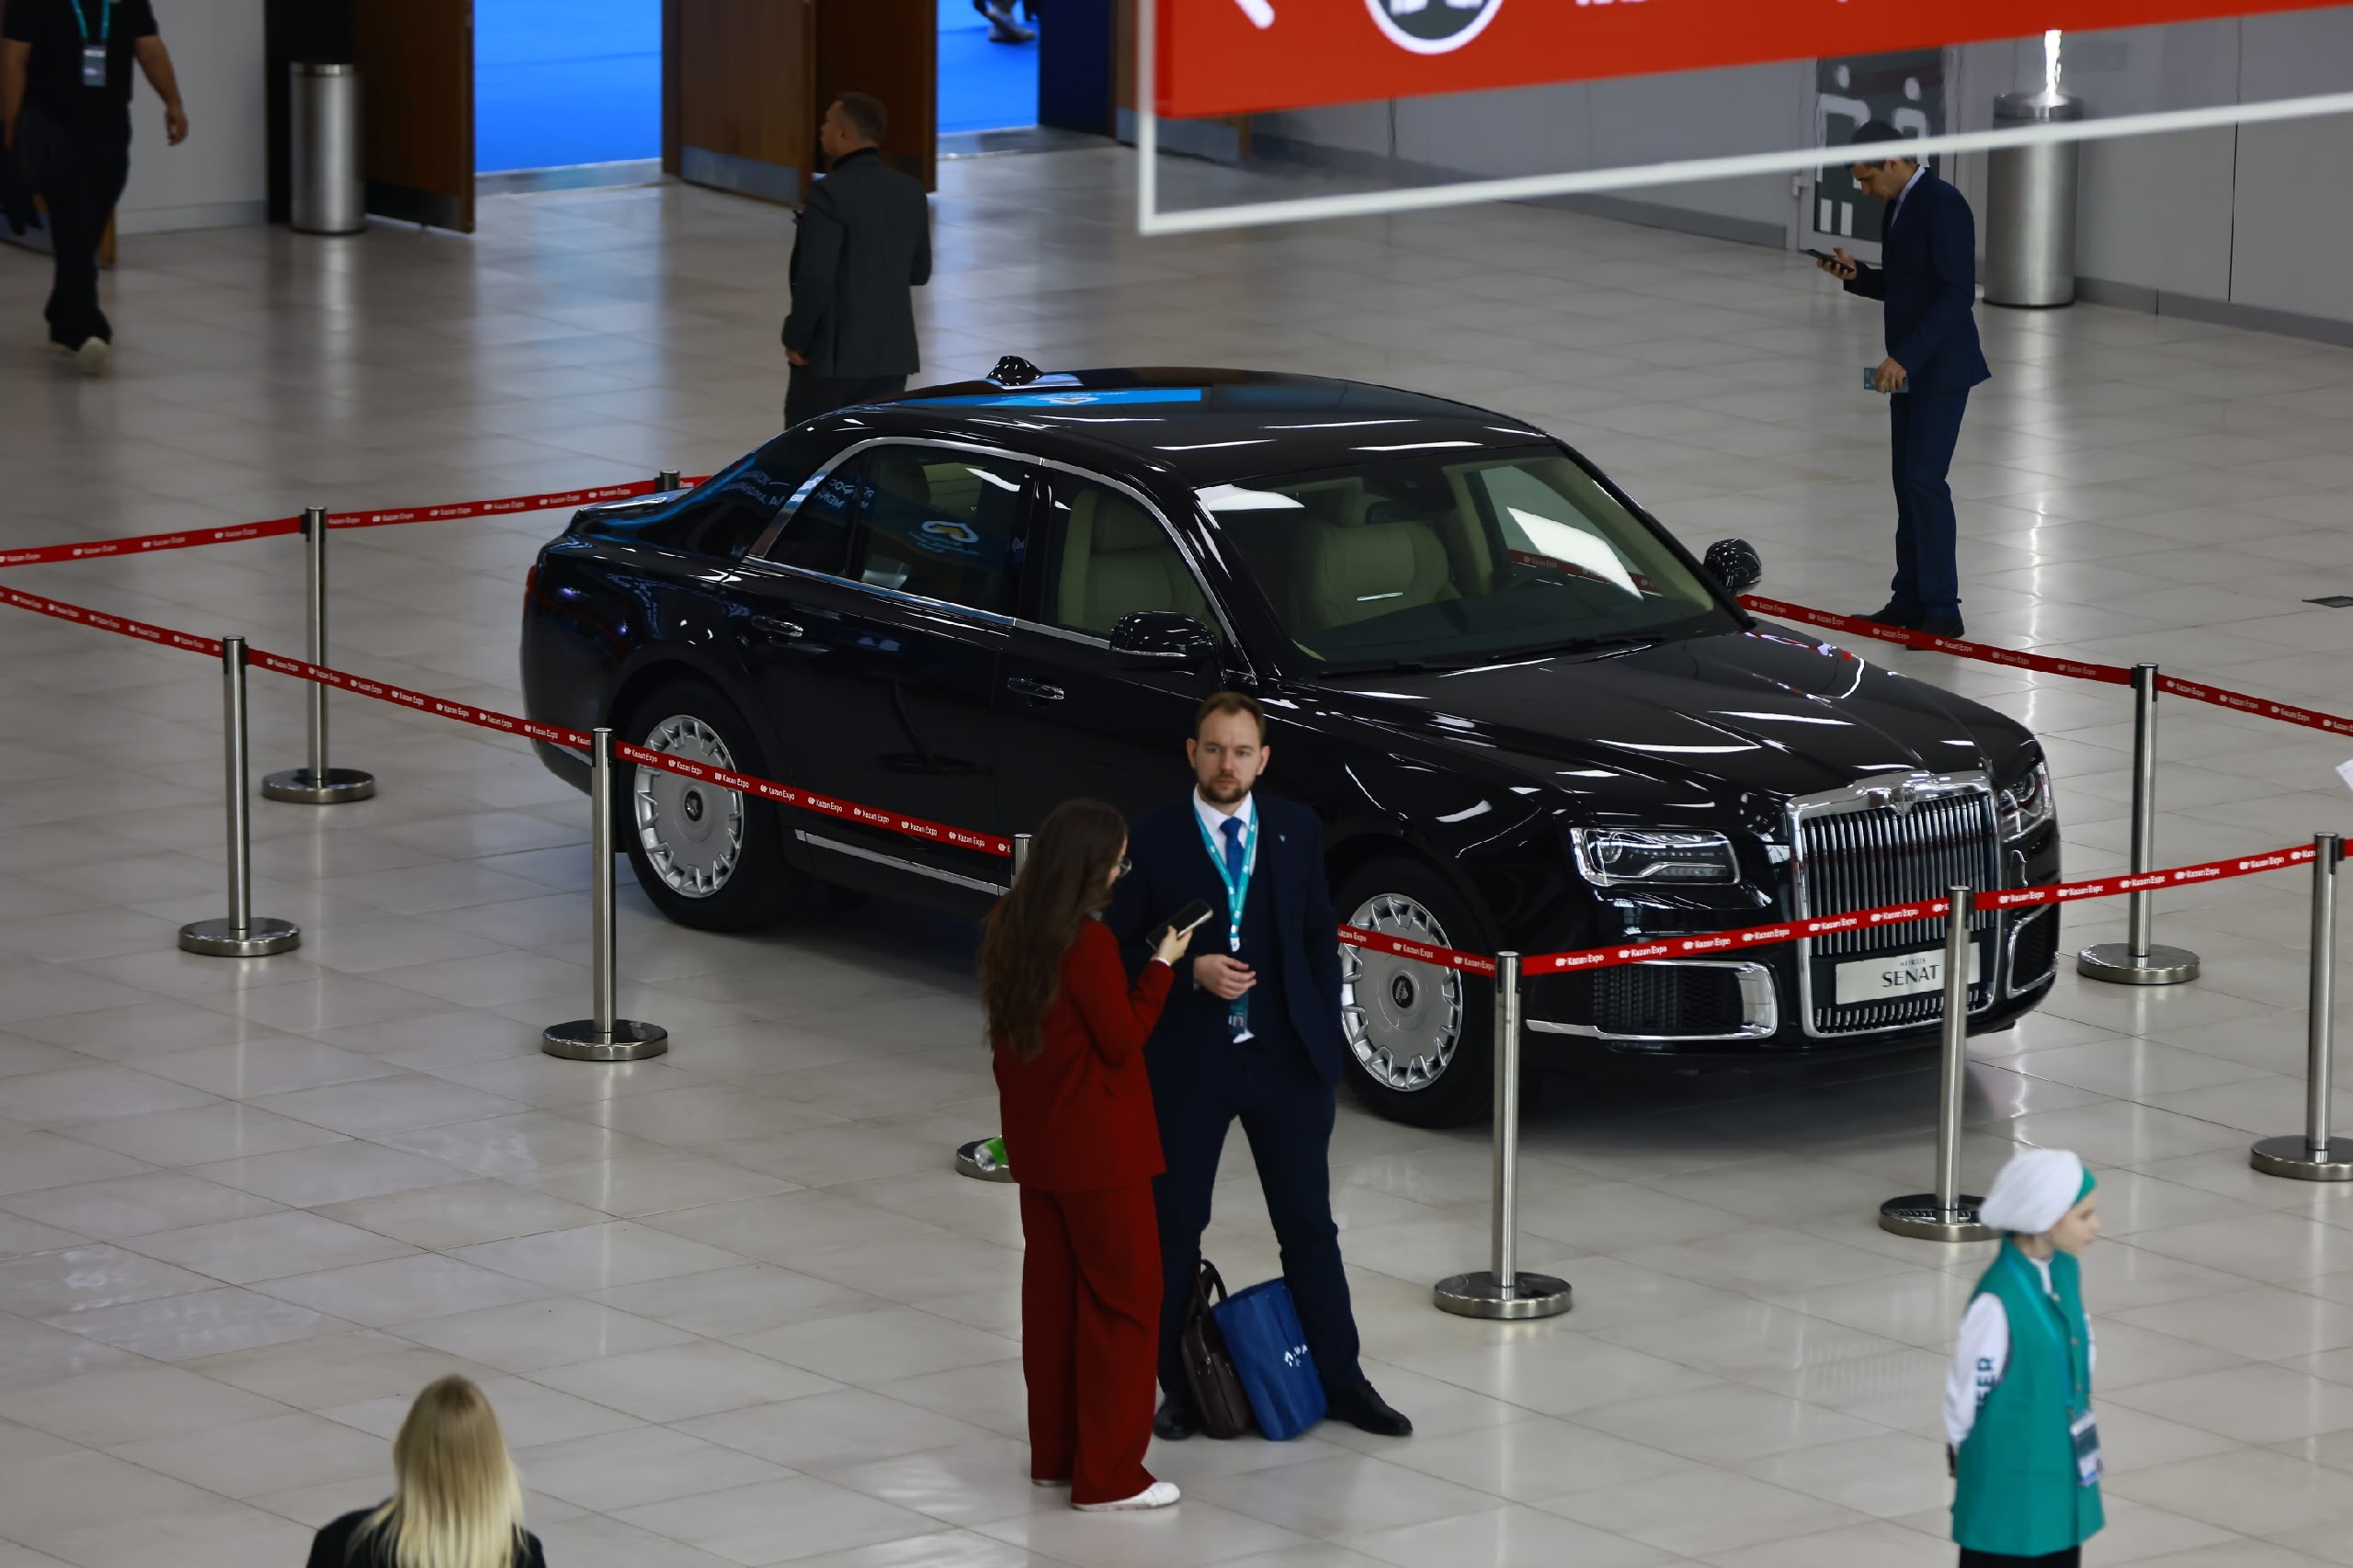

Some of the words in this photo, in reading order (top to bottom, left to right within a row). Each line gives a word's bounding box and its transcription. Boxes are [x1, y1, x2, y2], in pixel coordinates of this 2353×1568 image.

[546, 730, 558, 740] Expo
[631, 749, 645, 759] Kazan
[645, 753, 658, 763] Expo
[676, 761, 690, 771] Kazan
[691, 765, 703, 775] Expo
[722, 774, 736, 784] Kazan
[737, 778, 749, 789] Expo
[768, 787, 782, 797] Kazan
[782, 791, 795, 801] Expo
[816, 799, 831, 809] Kazan
[831, 802, 843, 812] Expo
[862, 810, 877, 821] Kazan
[877, 813, 889, 824] Expo
[910, 823, 925, 833] Kazan
[925, 826, 938, 836] Expo
[958, 833, 972, 843] Kazan
[972, 836, 985, 846] Expo
[2030, 891, 2045, 901] Expo
[2069, 887, 2088, 896] Kazan
[1883, 911, 1902, 920] Kazan
[1903, 908, 1918, 918] Expo
[1822, 921, 1841, 930] Kazan
[1841, 917, 1857, 928] Expo
[1755, 930, 1774, 940] Kazan
[1774, 928, 1790, 938] Expo
[1695, 940, 1714, 949] Kazan
[1714, 937, 1731, 948] Expo
[1631, 949, 1651, 958] Kazan
[1651, 946, 1667, 955] Expo
[1568, 957, 1586, 966] Kazan
[1587, 954, 1604, 963] Expo
[1900, 957, 1927, 967] AURUS
[1882, 964, 1940, 988] SENAT
